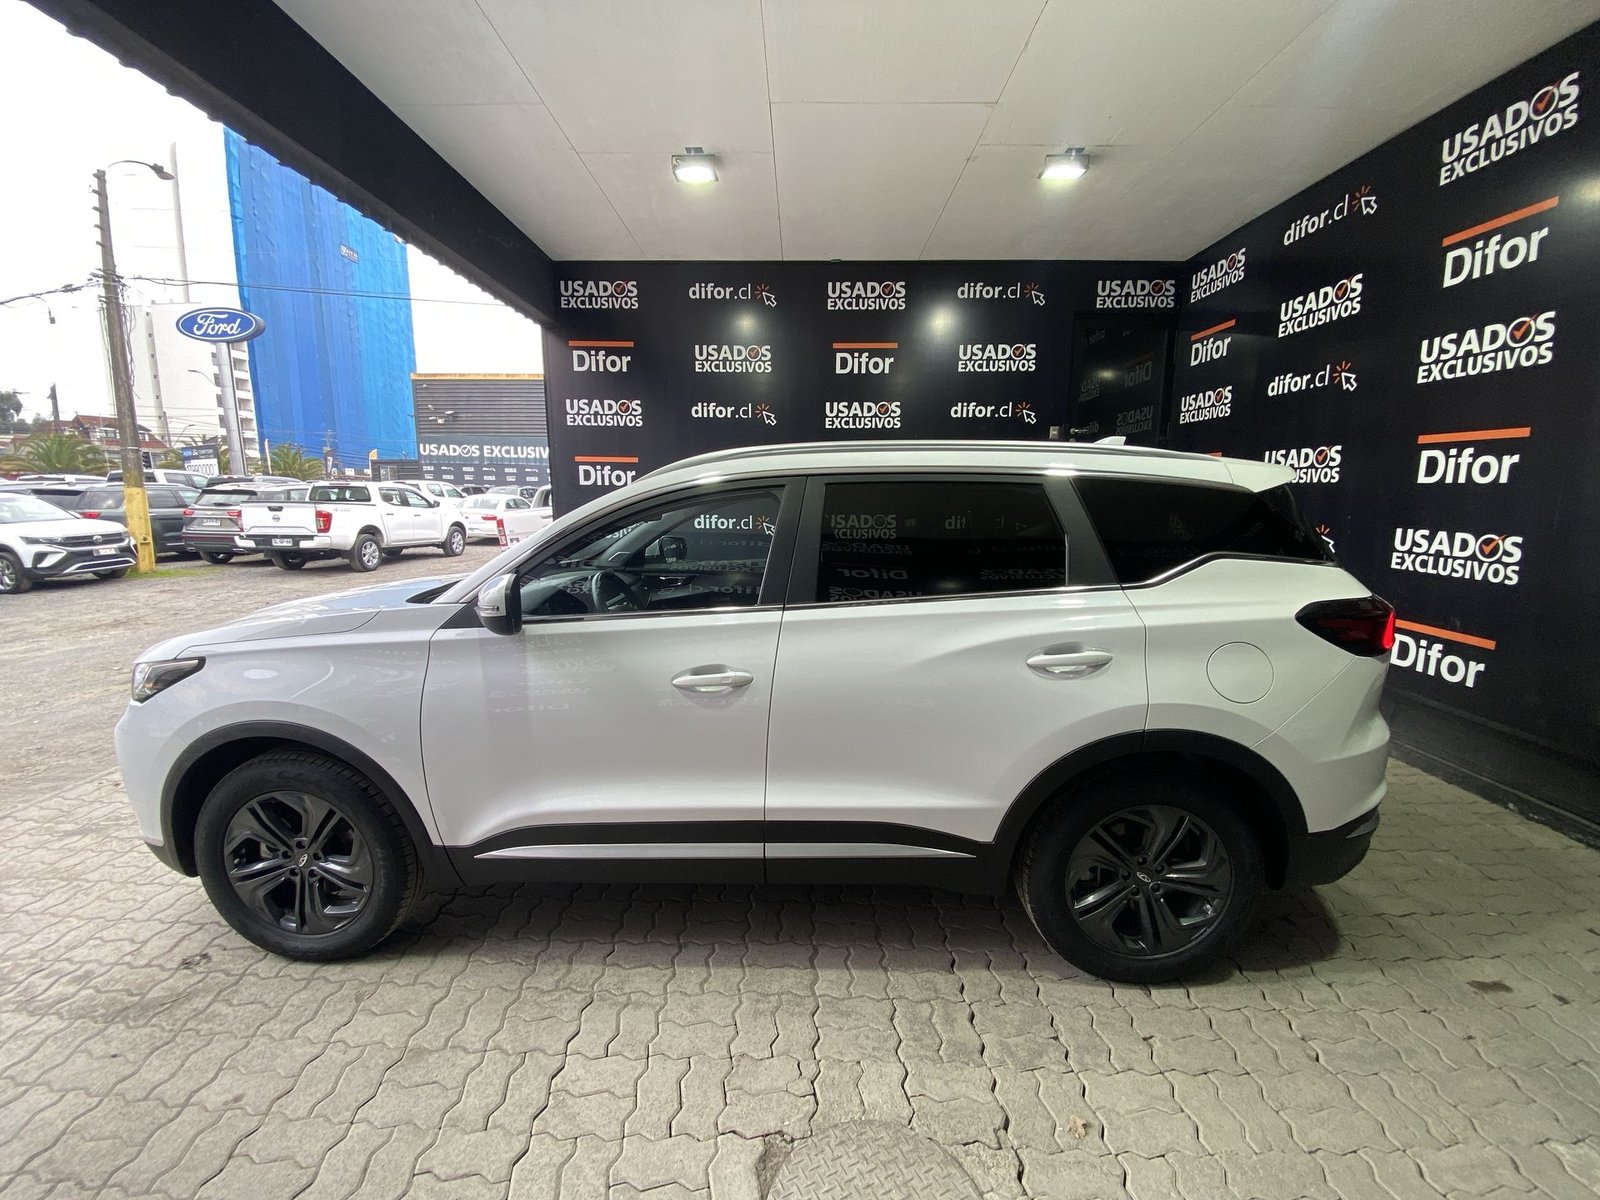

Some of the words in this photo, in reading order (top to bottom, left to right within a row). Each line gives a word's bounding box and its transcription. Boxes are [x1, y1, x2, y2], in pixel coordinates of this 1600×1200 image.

[1441, 71, 1580, 163] USADOS
[1439, 104, 1578, 186] EXCLUSIVOS
[1283, 194, 1349, 246] difor.cl
[1443, 227, 1548, 288] Difor
[1192, 247, 1246, 290] USADOS
[560, 280, 638, 297] USADOS
[688, 283, 751, 300] difor.cl
[827, 281, 906, 298] USADOS
[957, 282, 1021, 299] difor.cl
[1097, 280, 1175, 297] USADOS
[1190, 267, 1245, 303] EXCLUSIVOS
[560, 297, 639, 309] EXCLUSIVOS
[827, 298, 906, 310] EXCLUSIVOS
[1096, 296, 1175, 309] EXCLUSIVOS
[1280, 273, 1363, 322] USADOS
[193, 313, 242, 335] Ford
[1277, 297, 1361, 338] EXCLUSIVOS
[1420, 311, 1556, 364] USADOS
[572, 350, 631, 372] Difor
[694, 344, 772, 361] USADOS
[958, 343, 1037, 361] USADOS
[1190, 336, 1231, 367] Difor
[694, 361, 772, 373] EXCLUSIVOS
[835, 352, 895, 375] Difor
[957, 360, 1036, 372] EXCLUSIVOS
[1417, 342, 1553, 384] EXCLUSIVOS
[1267, 364, 1330, 396] difor.cl
[565, 399, 643, 415] USADOS
[825, 401, 902, 417] USADOS
[1181, 385, 1232, 412] USADOS
[566, 414, 643, 427] EXCLUSIVOS
[691, 402, 752, 419] difor.cl
[950, 401, 1013, 419] difor.cl
[1179, 403, 1231, 424] EXCLUSIVOS
[825, 417, 902, 429] EXCLUSIVOS
[420, 443, 480, 457] USADOS
[483, 445, 550, 459] EXCLUSIV
[578, 465, 636, 486] Difor
[1417, 447, 1520, 484] Difor
[693, 515, 753, 530] difor.cl
[1394, 528, 1523, 563] USADOS
[1390, 552, 1520, 586] EXCLUSIVOS
[1390, 633, 1485, 688] Difor
